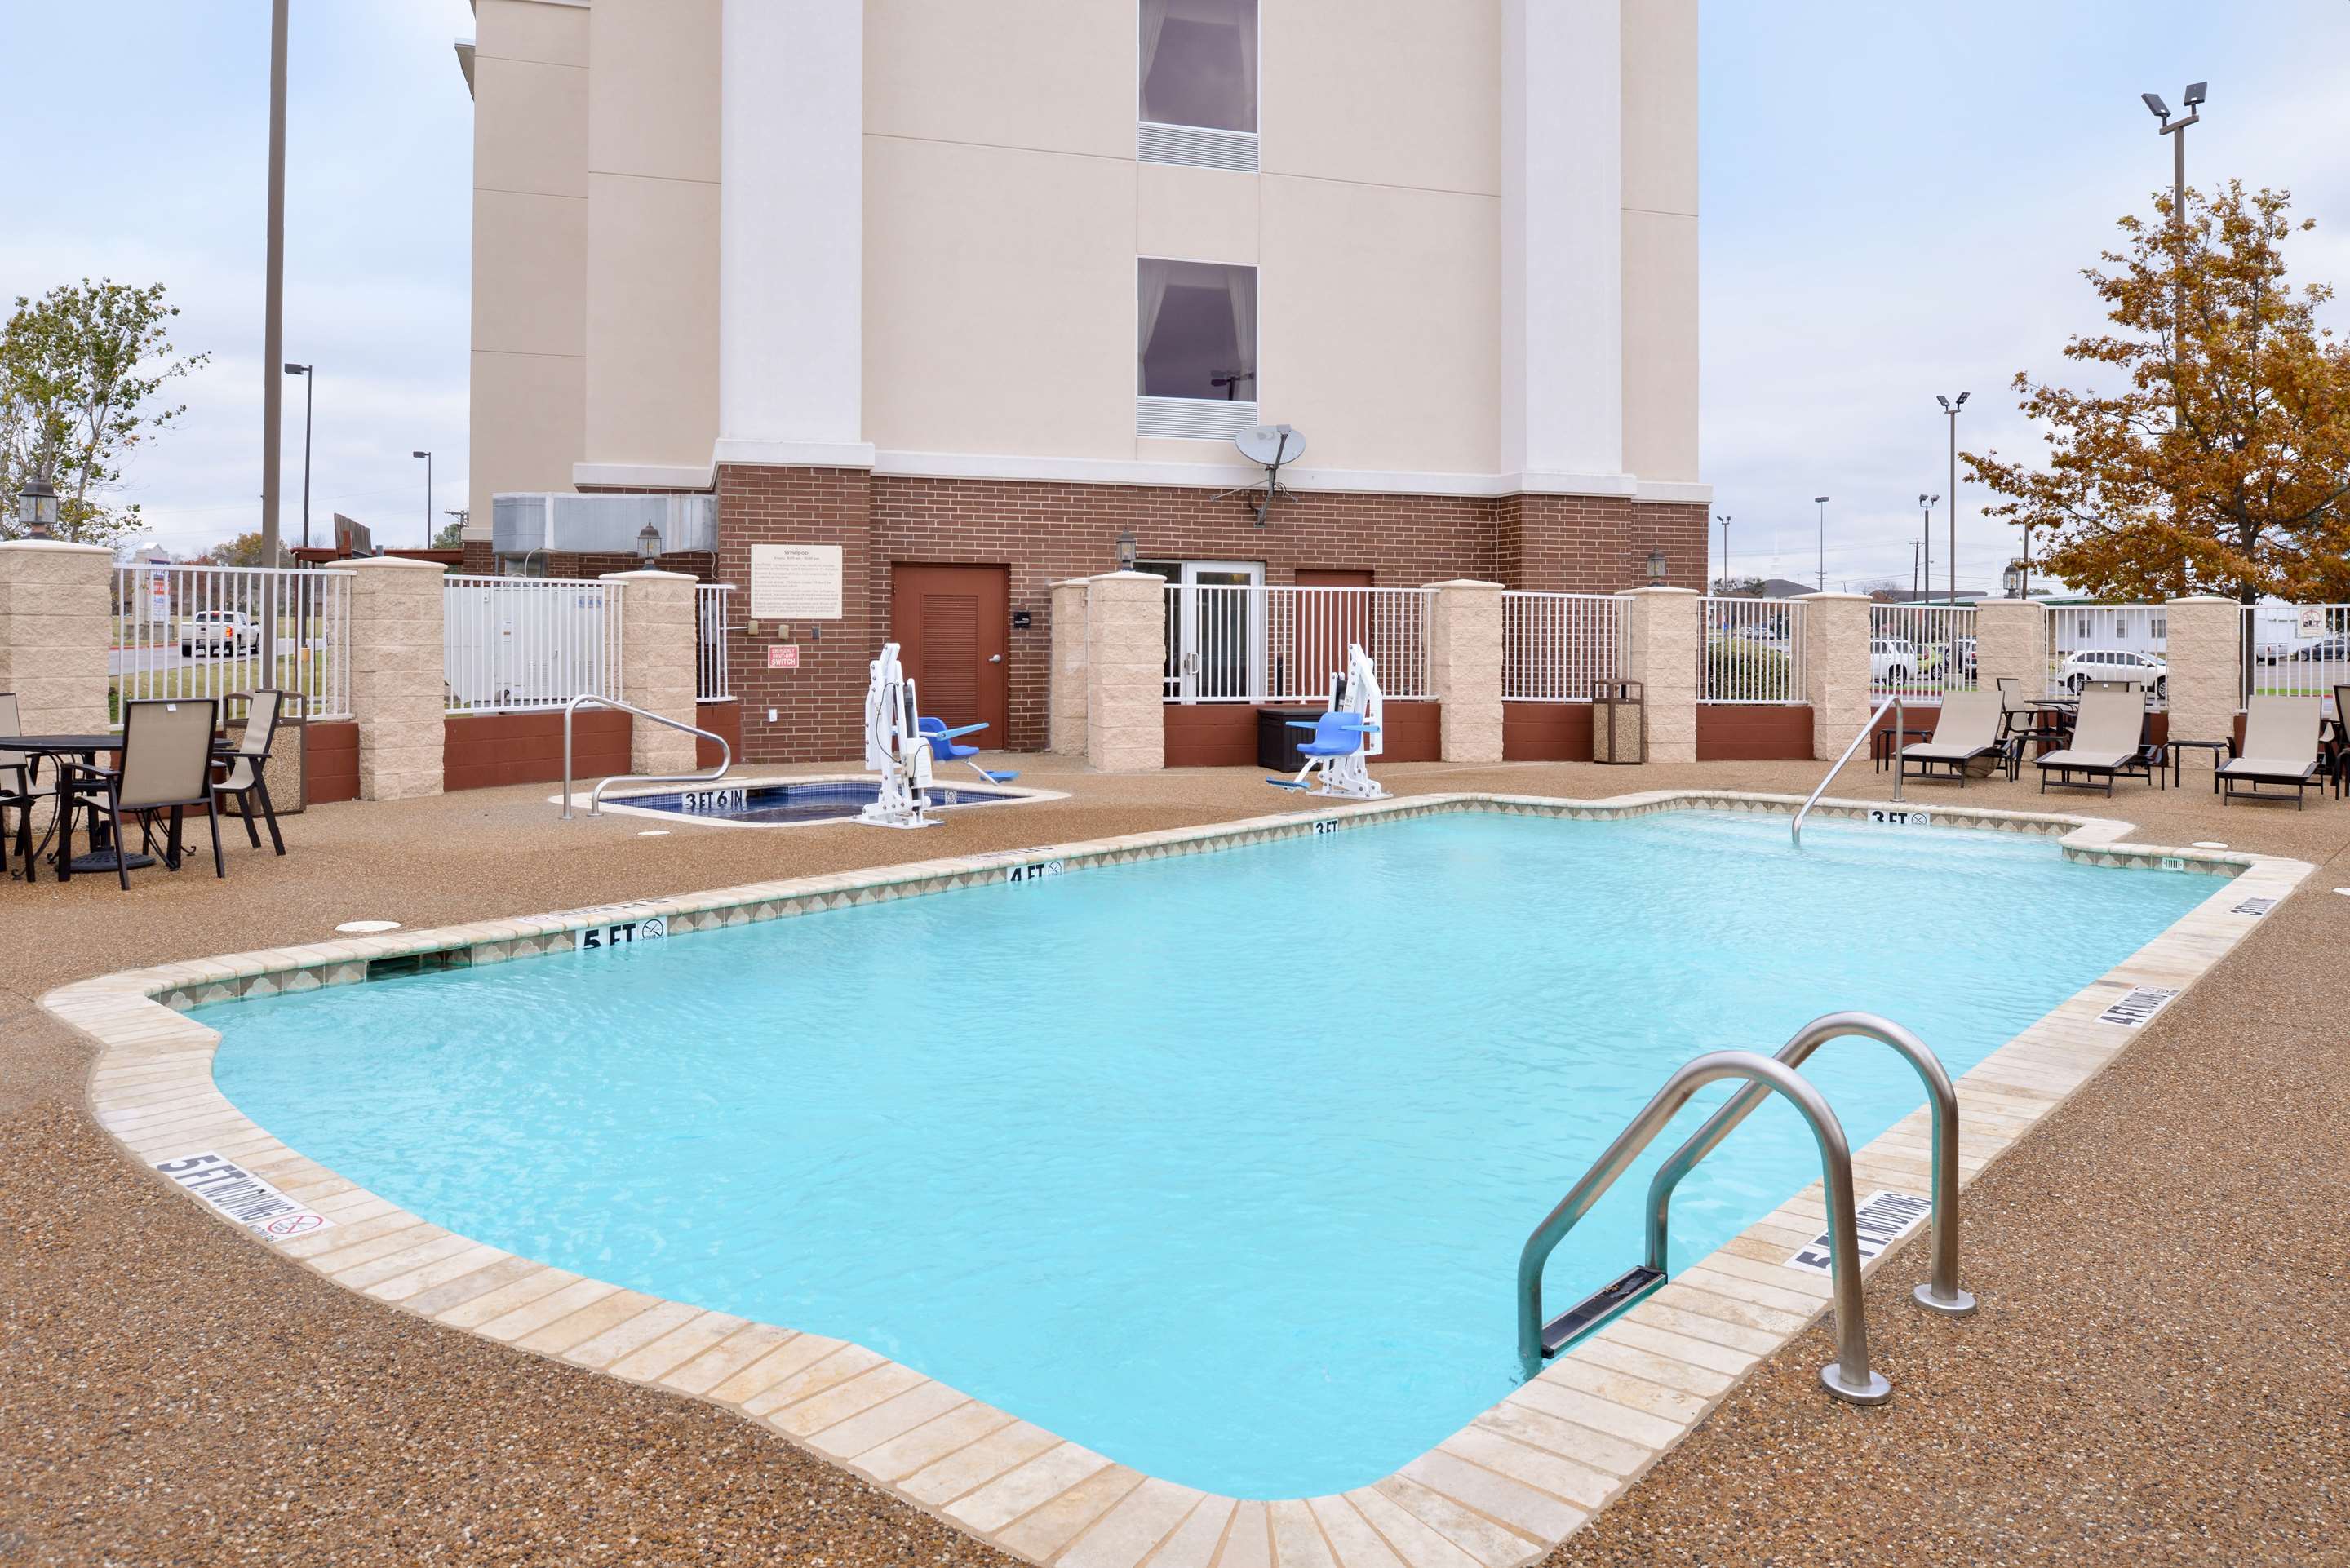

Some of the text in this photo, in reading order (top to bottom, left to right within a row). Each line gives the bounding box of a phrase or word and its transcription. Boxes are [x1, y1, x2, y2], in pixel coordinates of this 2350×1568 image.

[717, 791, 727, 807] 6
[731, 789, 742, 808] IN
[1028, 863, 1044, 879] FT
[583, 923, 636, 950] 5 FT
[2100, 1016, 2143, 1025] 4
[156, 1154, 220, 1172] 5
